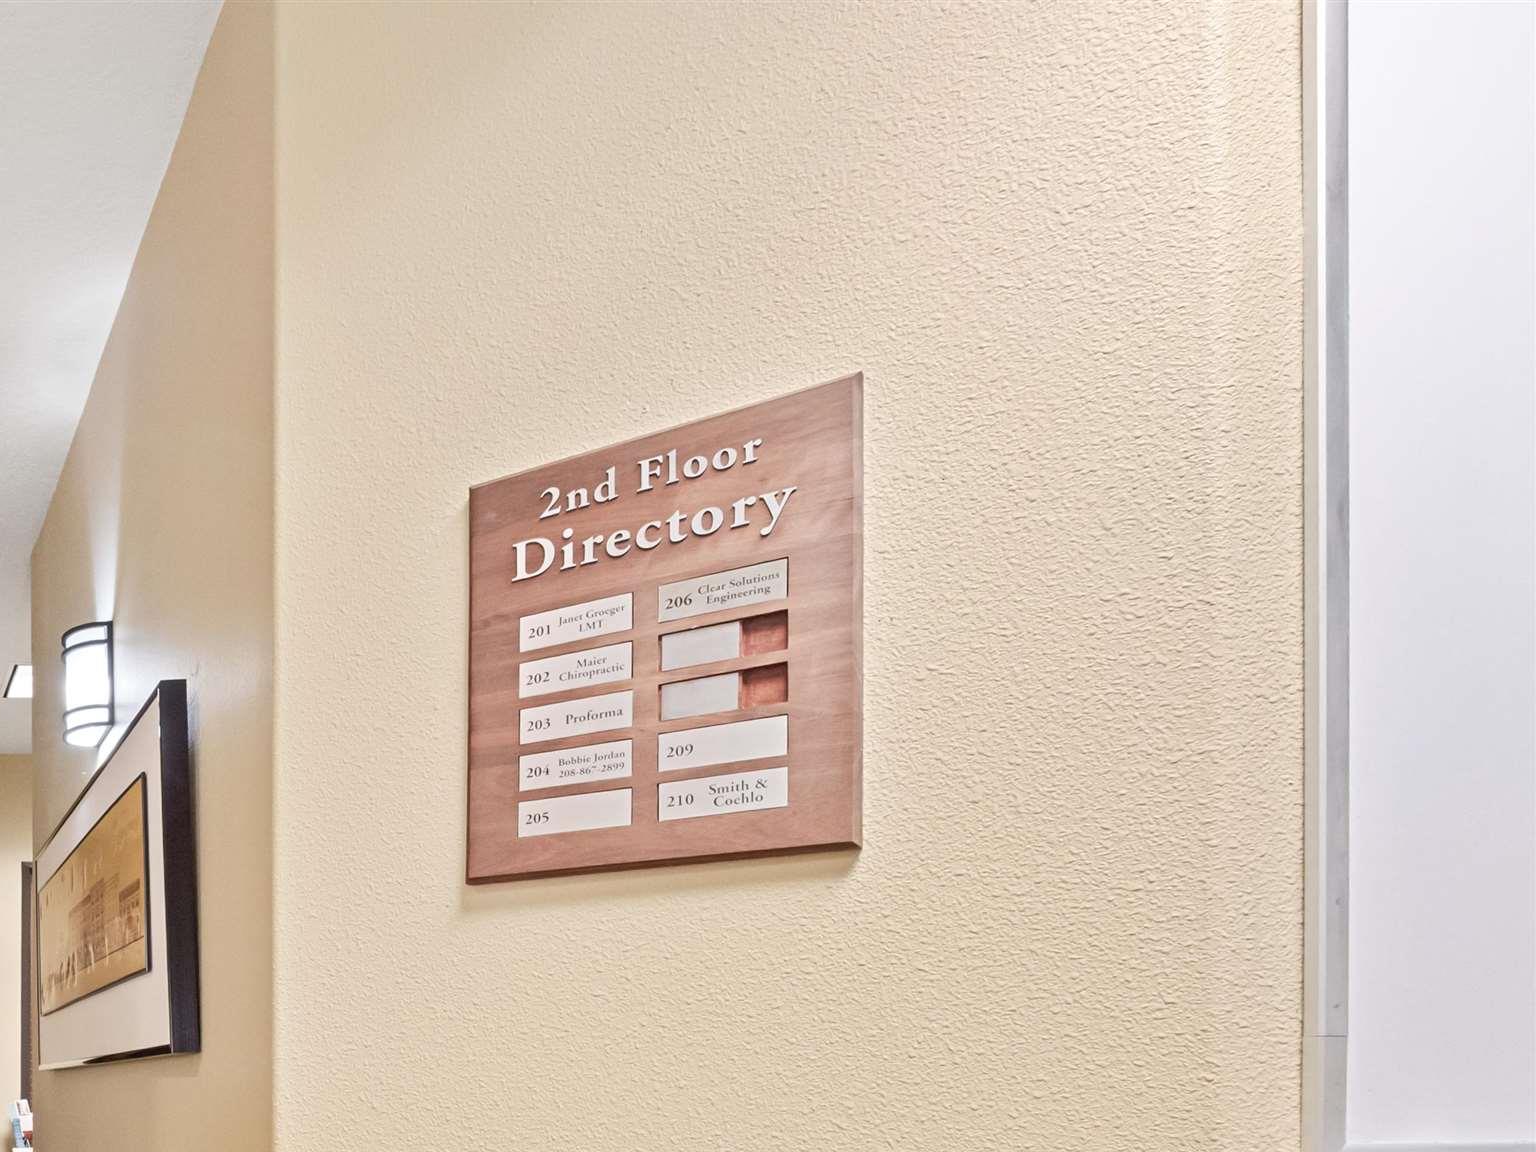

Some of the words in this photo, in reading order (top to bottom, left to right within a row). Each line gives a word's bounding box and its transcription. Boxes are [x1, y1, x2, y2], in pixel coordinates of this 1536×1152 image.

[538, 465, 619, 521] 2nd
[636, 436, 763, 495] Floor
[510, 486, 798, 583] Directory
[697, 583, 726, 595] Clear
[729, 571, 780, 588] Solutions
[665, 592, 693, 610] 206
[706, 585, 772, 605] Engineering
[558, 615, 583, 627] Janet
[579, 620, 604, 633] LMT
[528, 624, 551, 639] 201
[576, 656, 607, 669] Maier
[526, 671, 550, 686] 202
[558, 662, 625, 682] Chiropractic
[527, 717, 551, 732] 203
[565, 708, 623, 725] Proforma
[666, 743, 694, 758] 209
[558, 755, 592, 767] Bobbie
[594, 751, 625, 764] Jordan
[526, 765, 550, 779] 204
[708, 779, 749, 796] Smith
[755, 778, 768, 790] &
[667, 793, 695, 808] 210
[525, 811, 550, 825] 205
